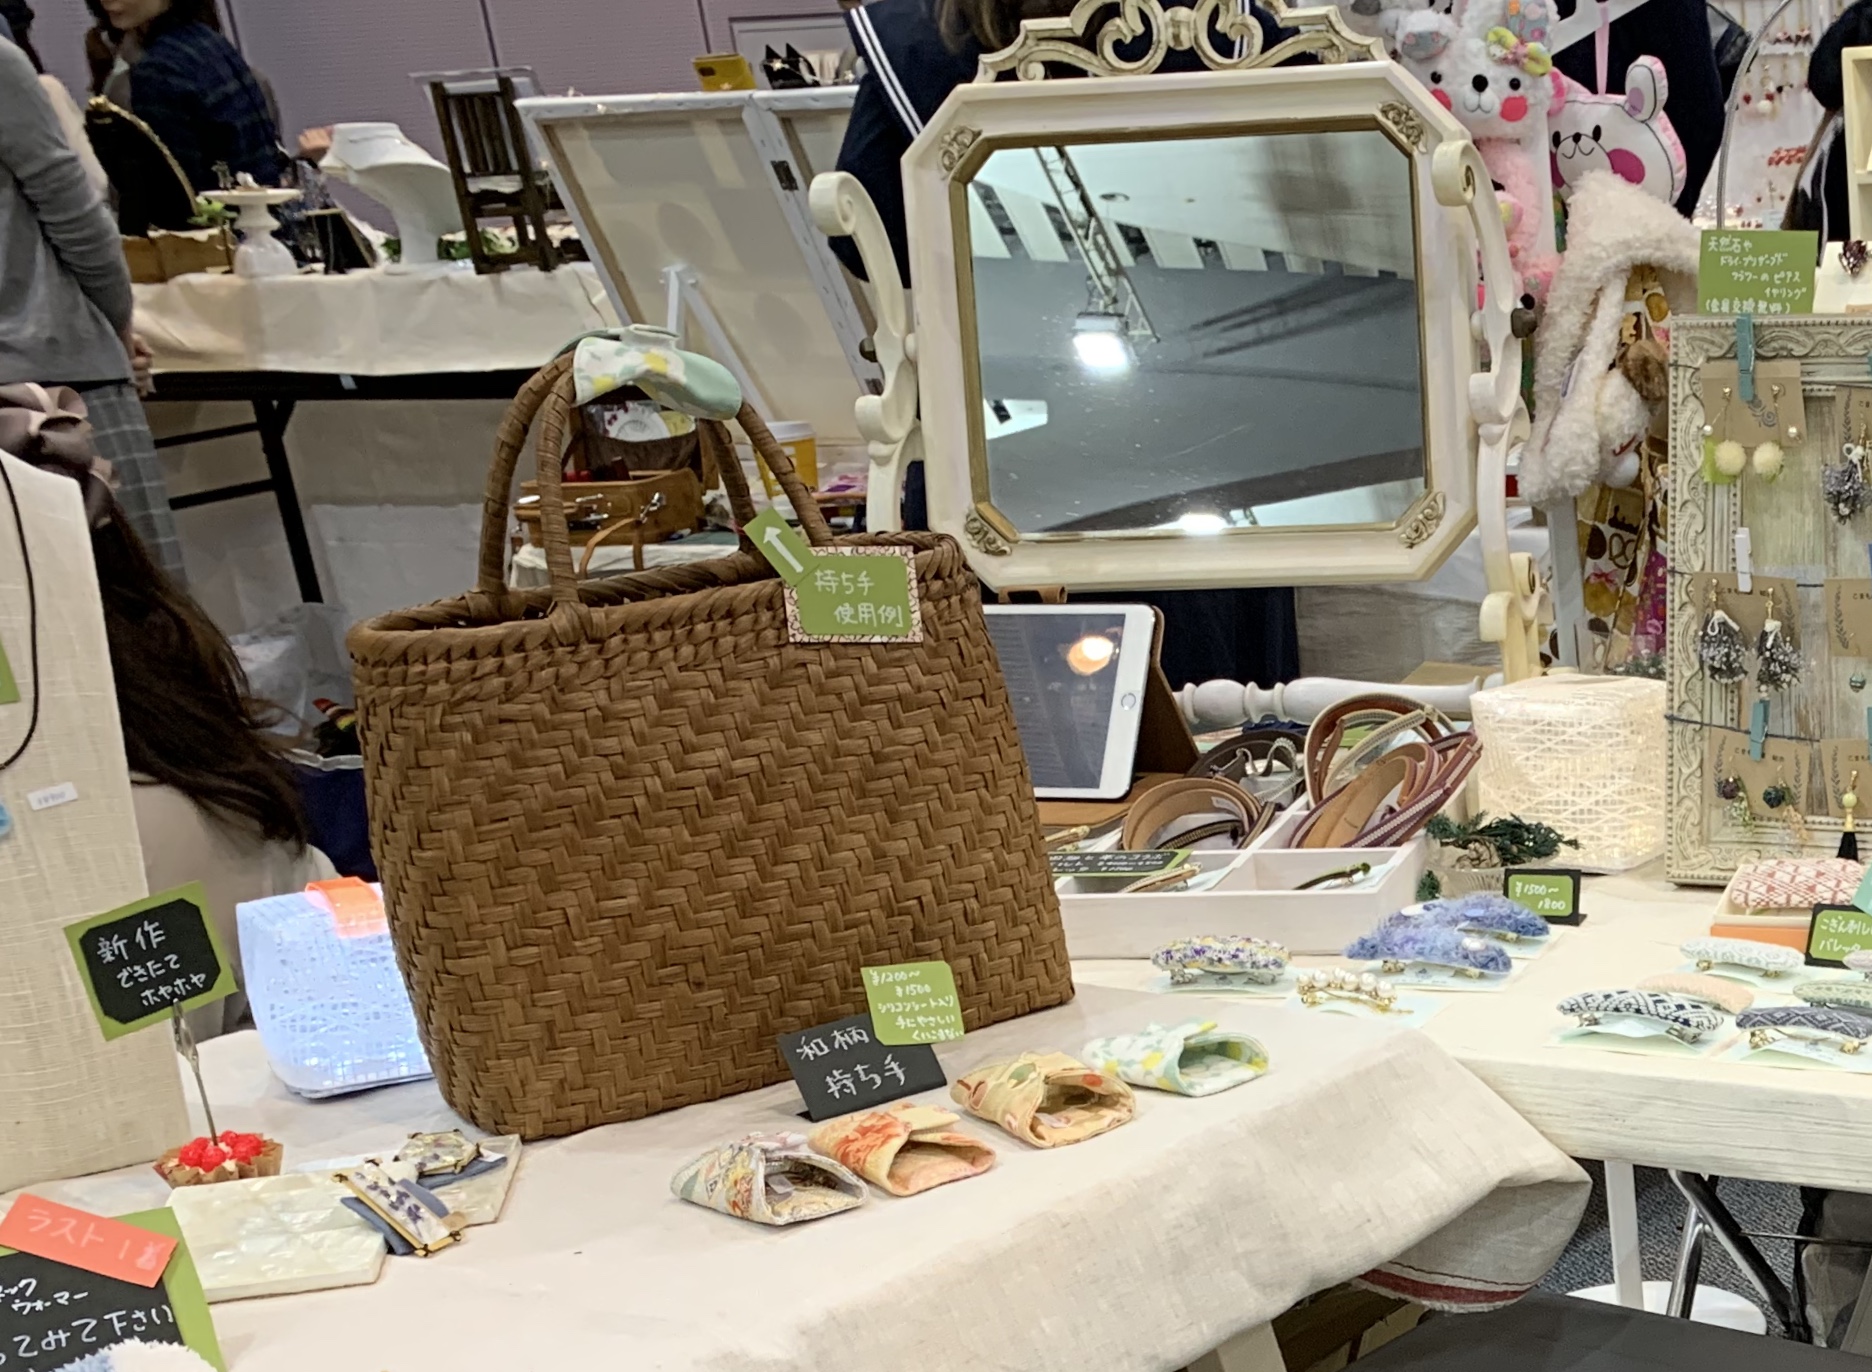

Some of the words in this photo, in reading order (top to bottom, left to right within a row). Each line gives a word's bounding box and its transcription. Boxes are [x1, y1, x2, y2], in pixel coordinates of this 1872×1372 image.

[1764, 287, 1807, 300] イヤリング
[814, 569, 875, 596] 持ち手
[833, 602, 904, 628] 使用例
[1537, 897, 1566, 911] 1800
[97, 920, 166, 964] 新作
[116, 953, 181, 989] できたて
[140, 972, 206, 1006] ホヤホヤ
[895, 983, 931, 997] ¥1500
[895, 1015, 956, 1030] 手にやさしい
[796, 1026, 870, 1061] 和柄
[825, 1053, 907, 1100] 持ち手
[0, 1277, 37, 1297] ック
